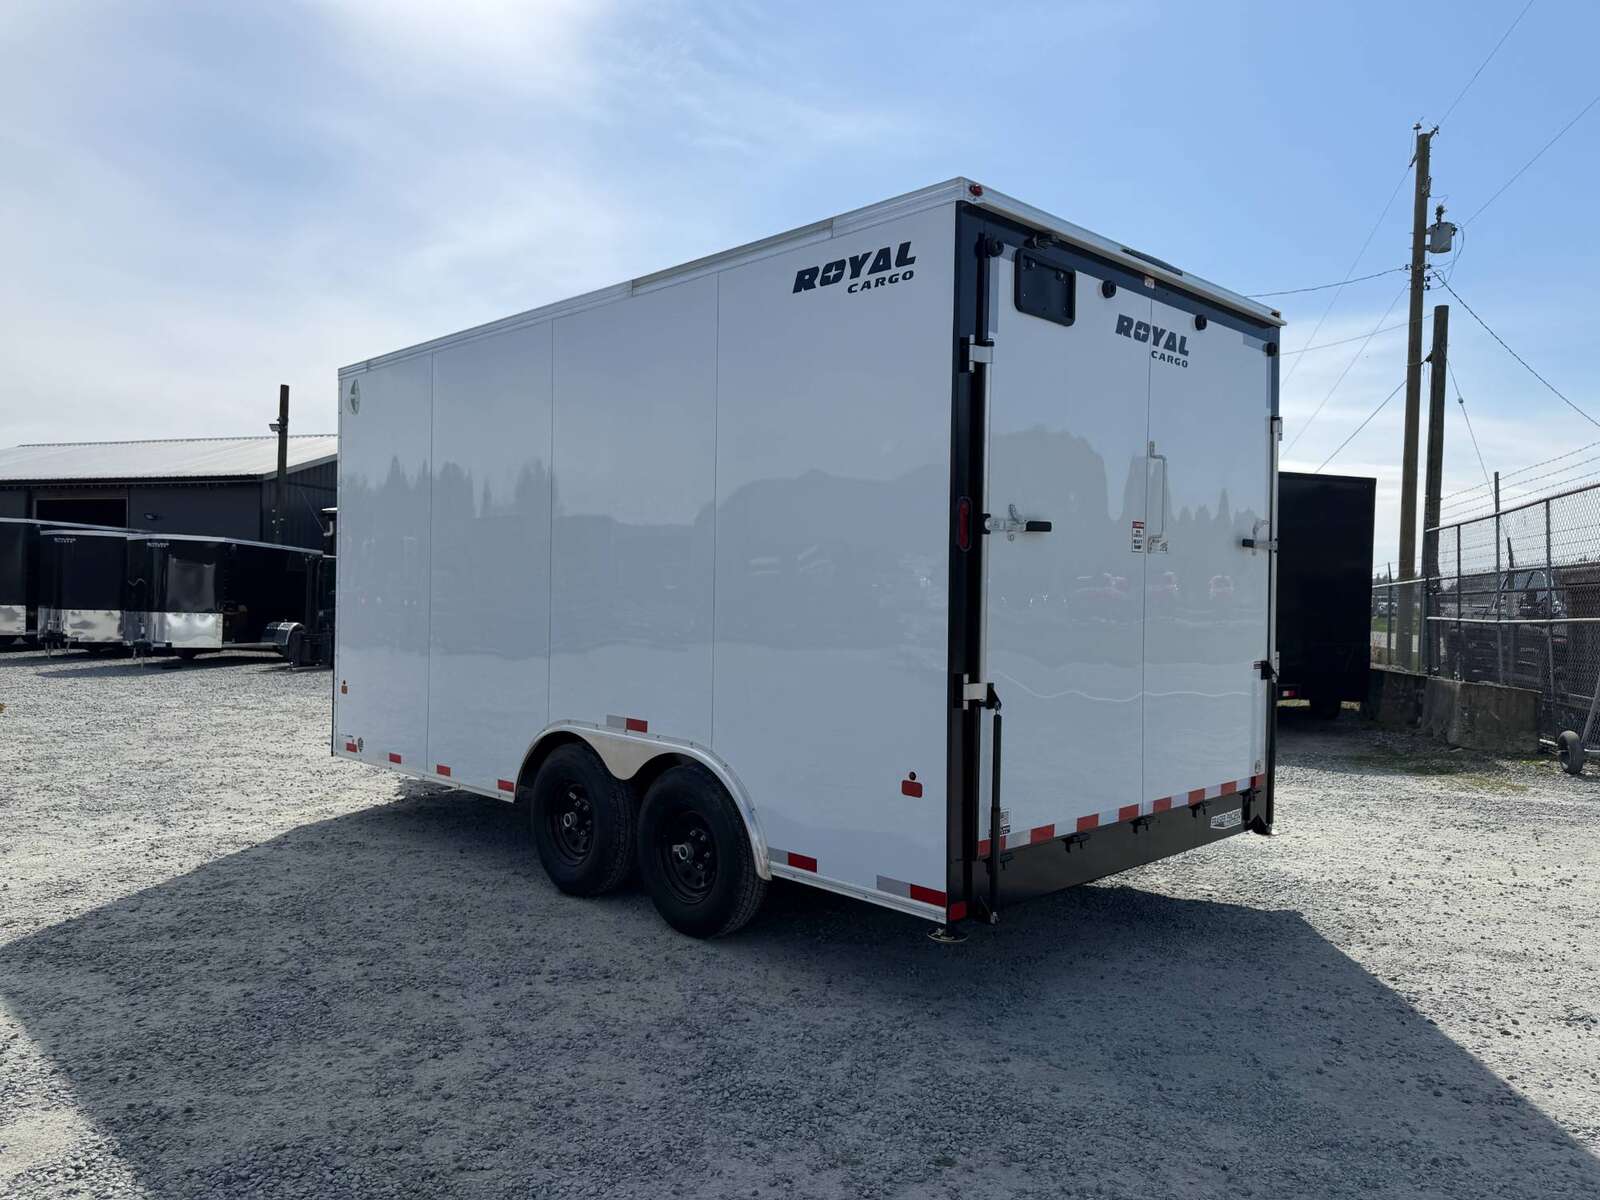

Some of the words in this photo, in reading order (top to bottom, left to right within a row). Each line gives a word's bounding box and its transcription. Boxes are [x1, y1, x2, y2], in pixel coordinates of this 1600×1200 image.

[792, 241, 917, 294] ROYAL
[847, 270, 914, 294] CARGO
[1115, 313, 1189, 357] ROYAL
[1151, 350, 1188, 368] CARGO
